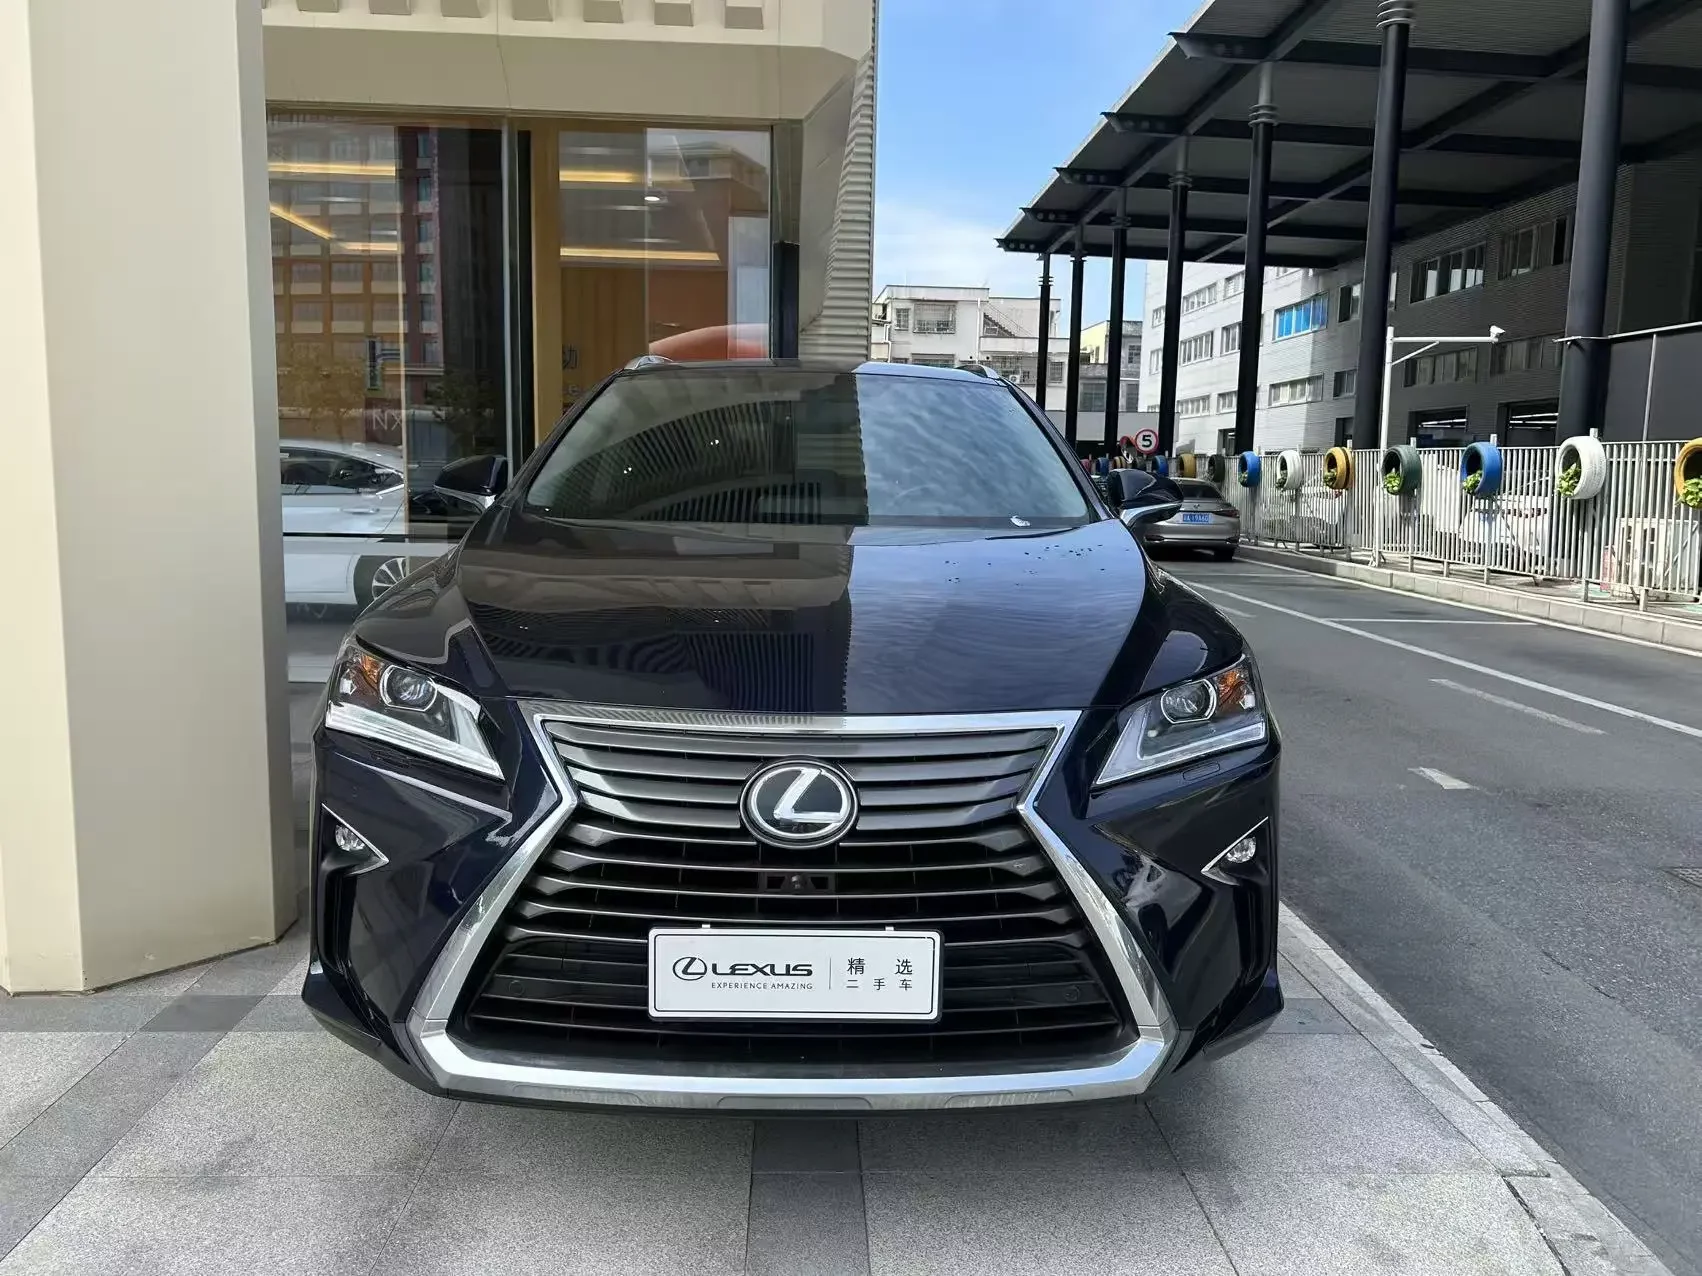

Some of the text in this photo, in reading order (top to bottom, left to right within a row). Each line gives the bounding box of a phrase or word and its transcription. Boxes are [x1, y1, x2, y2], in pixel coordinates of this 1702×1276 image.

[1141, 434, 1152, 448] 5
[711, 962, 813, 977] LEXUS
[847, 957, 913, 976] 精选
[711, 981, 813, 991] EXPERIENCE AMAZING
[846, 977, 913, 991] 二手车
